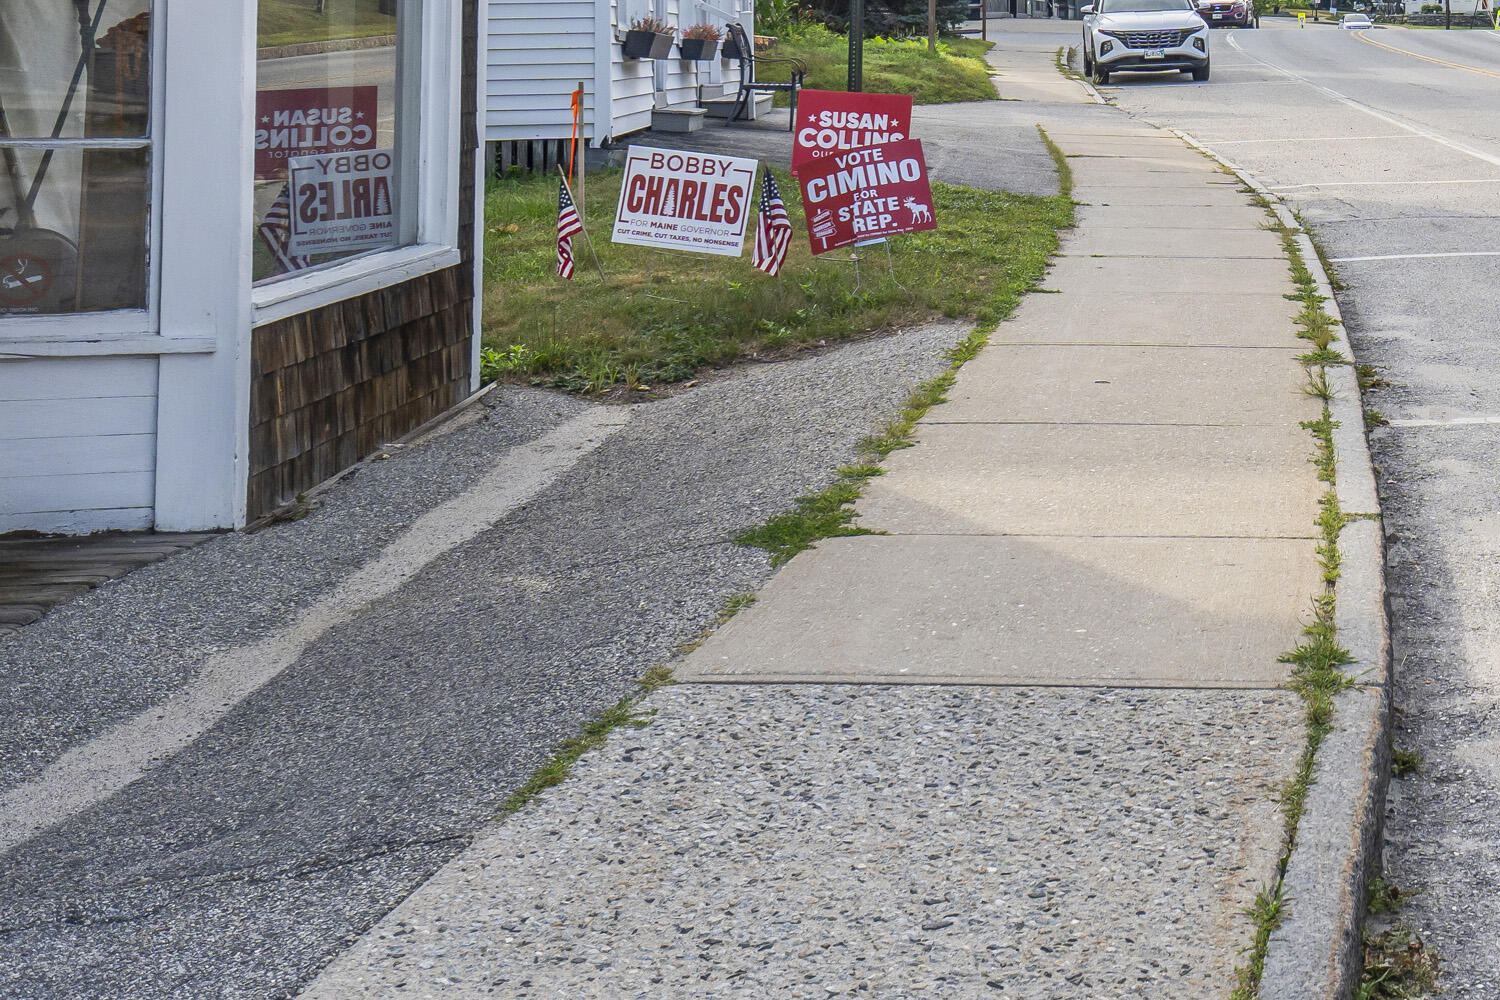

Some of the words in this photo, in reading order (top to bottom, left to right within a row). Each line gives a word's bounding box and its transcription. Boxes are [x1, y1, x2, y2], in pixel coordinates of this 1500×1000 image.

[818, 110, 889, 131] SUSAN
[650, 152, 733, 177] BOBBY
[834, 148, 884, 169] VOTE
[806, 158, 921, 203] CIMINO
[626, 173, 744, 224] CHARLES
[853, 189, 878, 202] FOR
[838, 196, 900, 222] STATE
[630, 219, 648, 227] FOR
[650, 221, 678, 231] MAINE
[680, 224, 730, 237] GOVERNOR
[852, 213, 898, 235] REP.
[703, 238, 740, 248] NONSENSE
